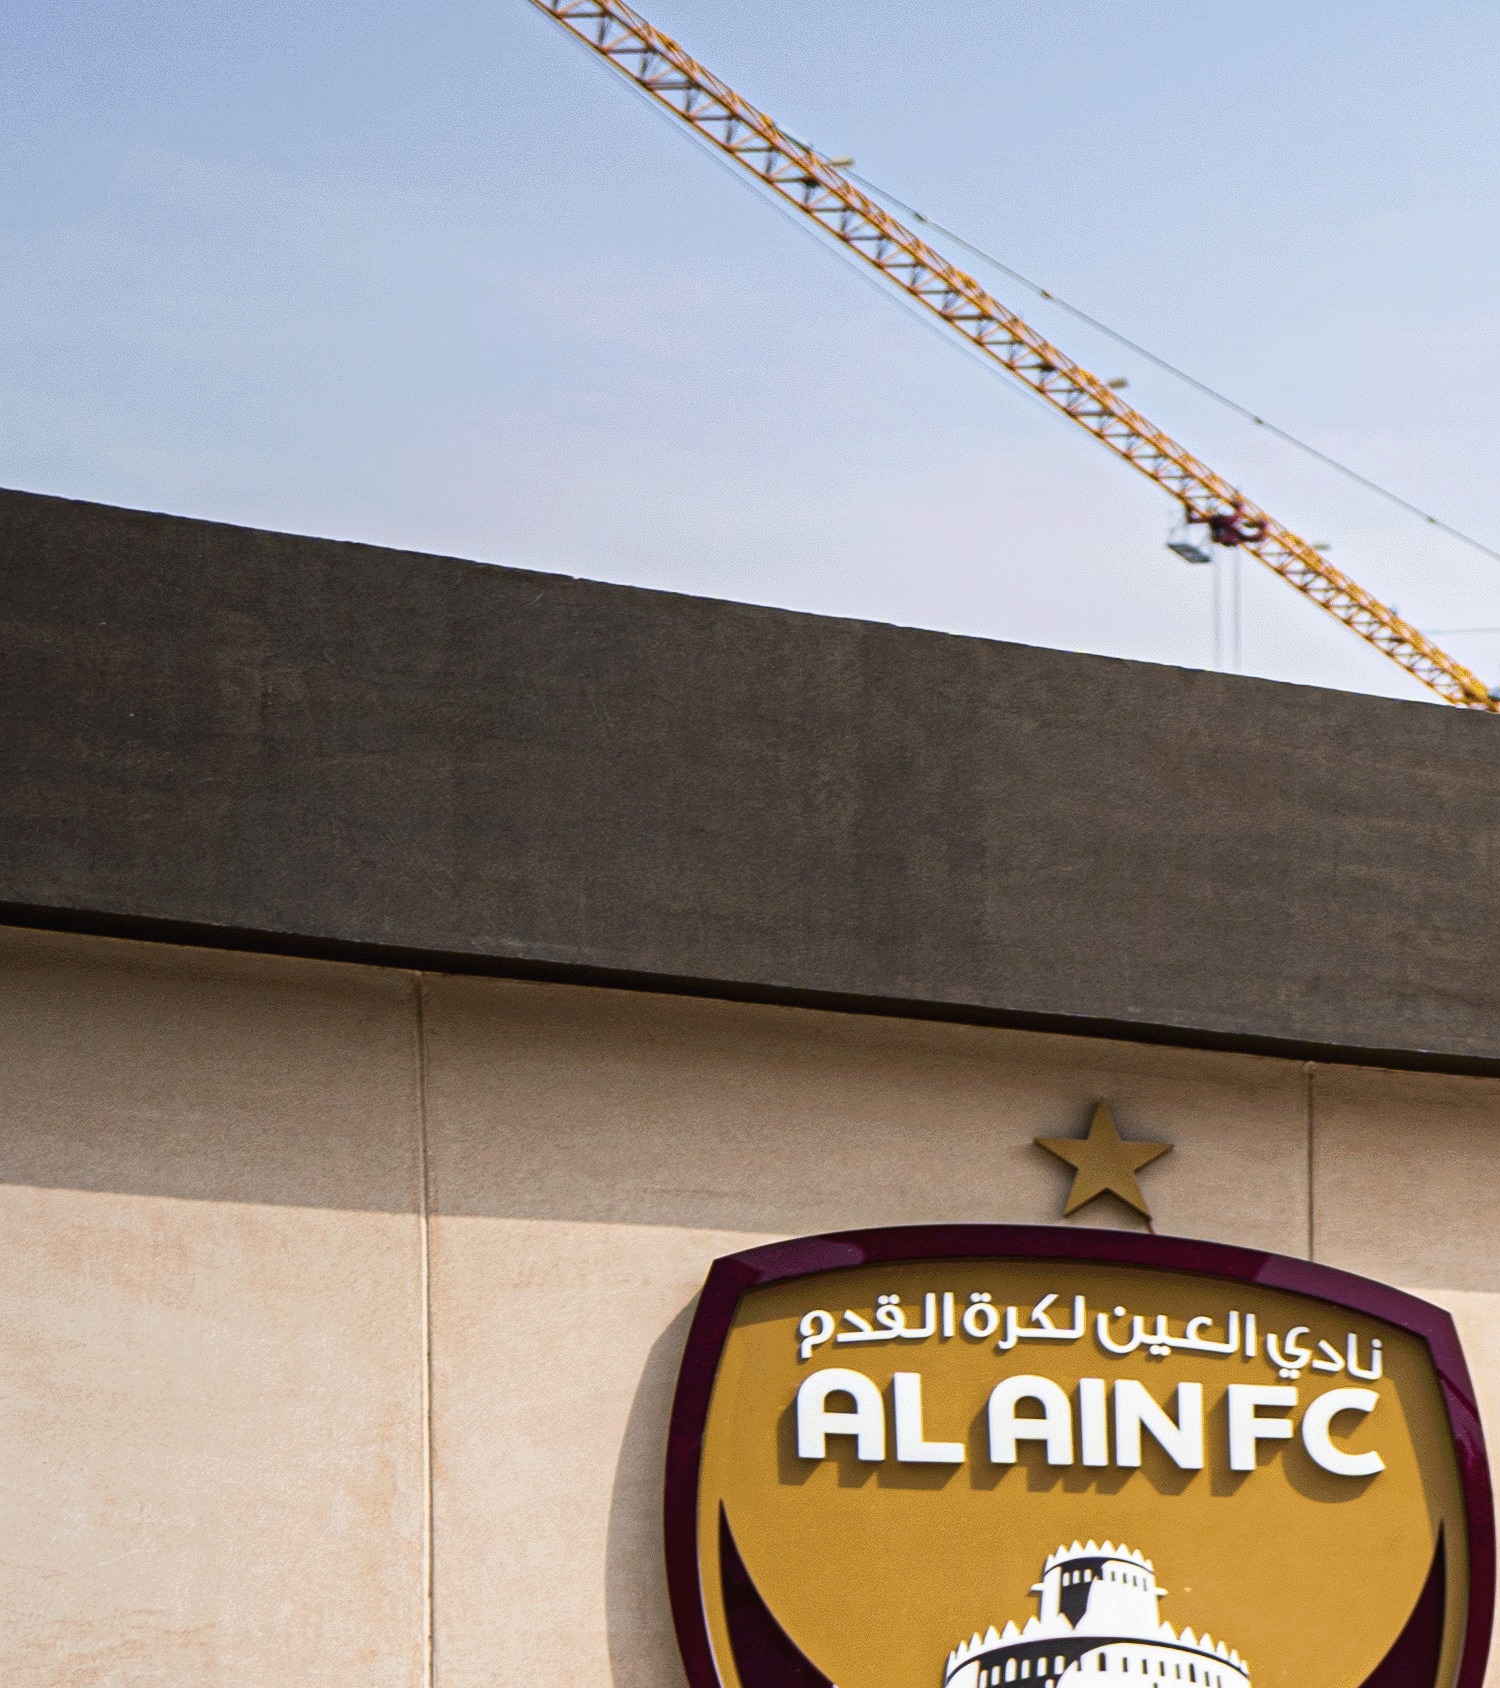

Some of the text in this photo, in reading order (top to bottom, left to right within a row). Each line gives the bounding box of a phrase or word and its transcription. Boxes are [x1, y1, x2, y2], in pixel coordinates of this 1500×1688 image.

[799, 1291, 1383, 1380] نادي العين لكرة القدم
[796, 1367, 1386, 1477] AL AIN FC
